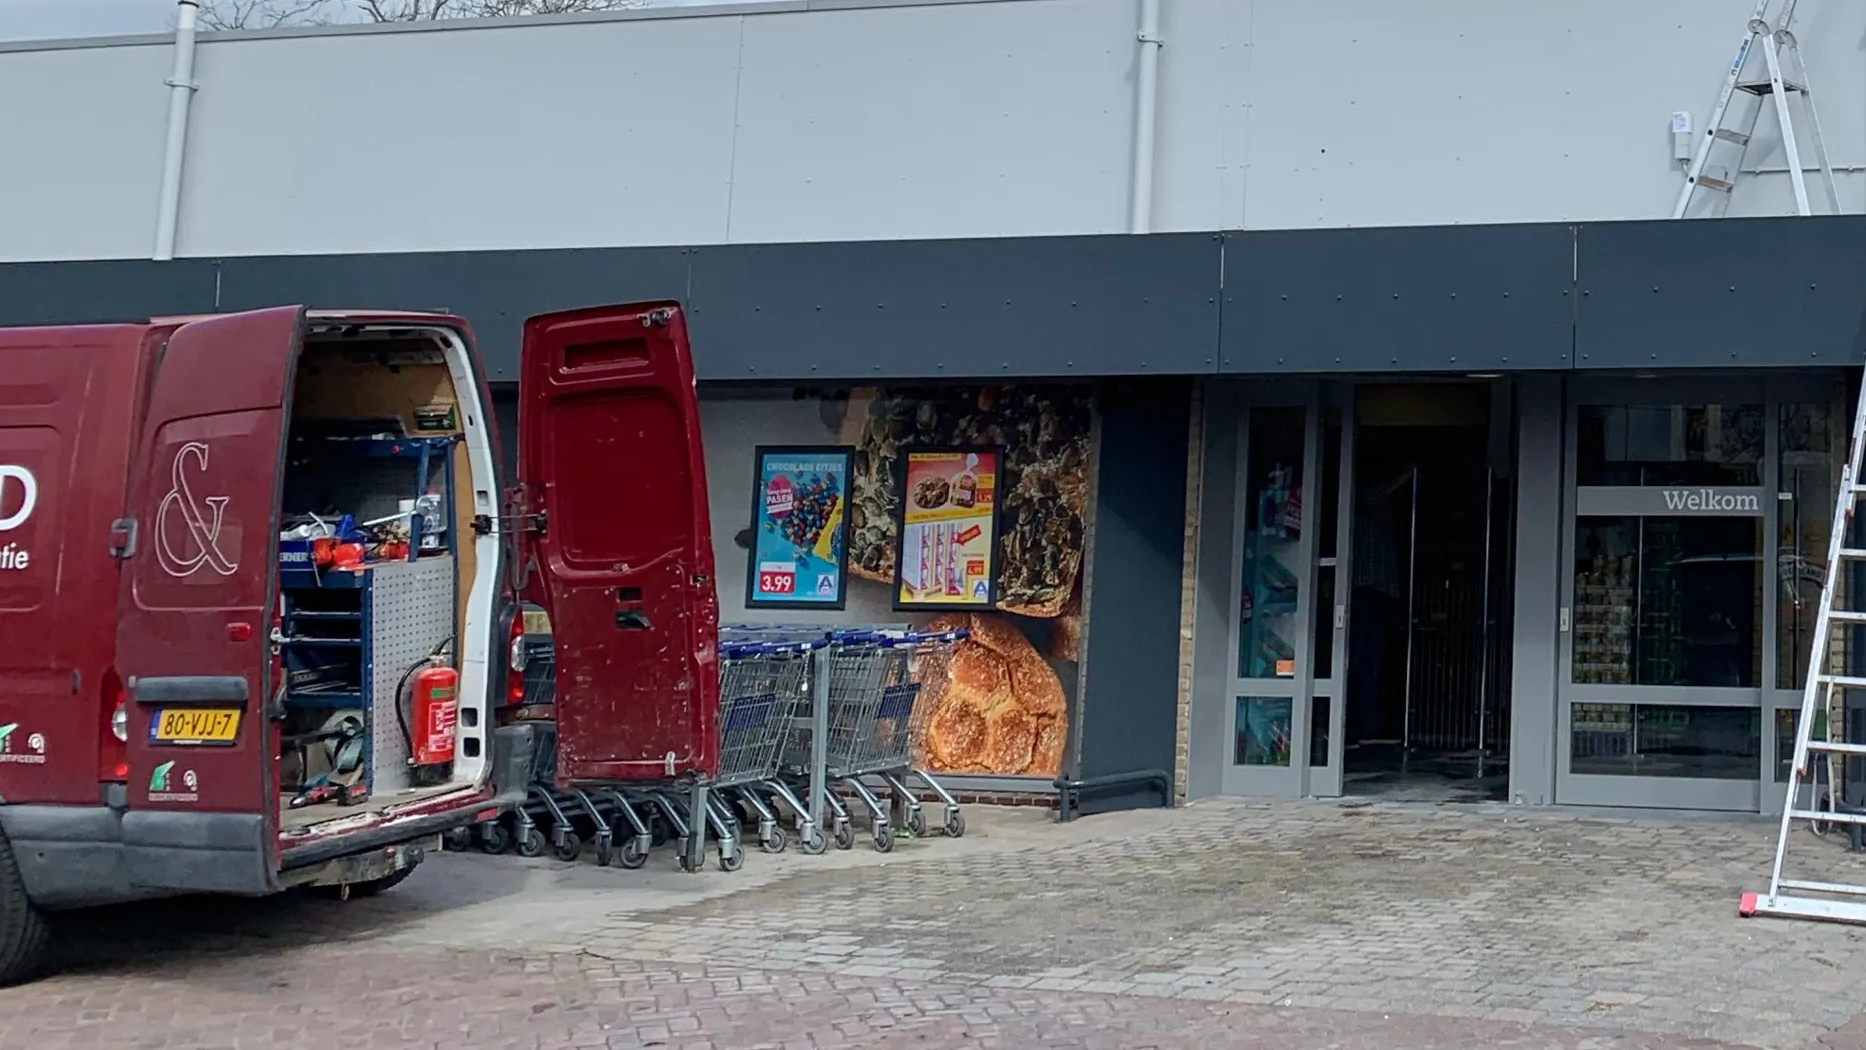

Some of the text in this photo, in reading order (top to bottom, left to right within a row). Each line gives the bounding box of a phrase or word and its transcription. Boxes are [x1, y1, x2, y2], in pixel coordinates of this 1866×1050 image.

[766, 493, 794, 506] PASEN
[1662, 488, 1759, 511] Welkom
[0, 542, 30, 570] tie
[761, 574, 793, 592] 3.99
[163, 712, 233, 737] 80-VJJ-7
